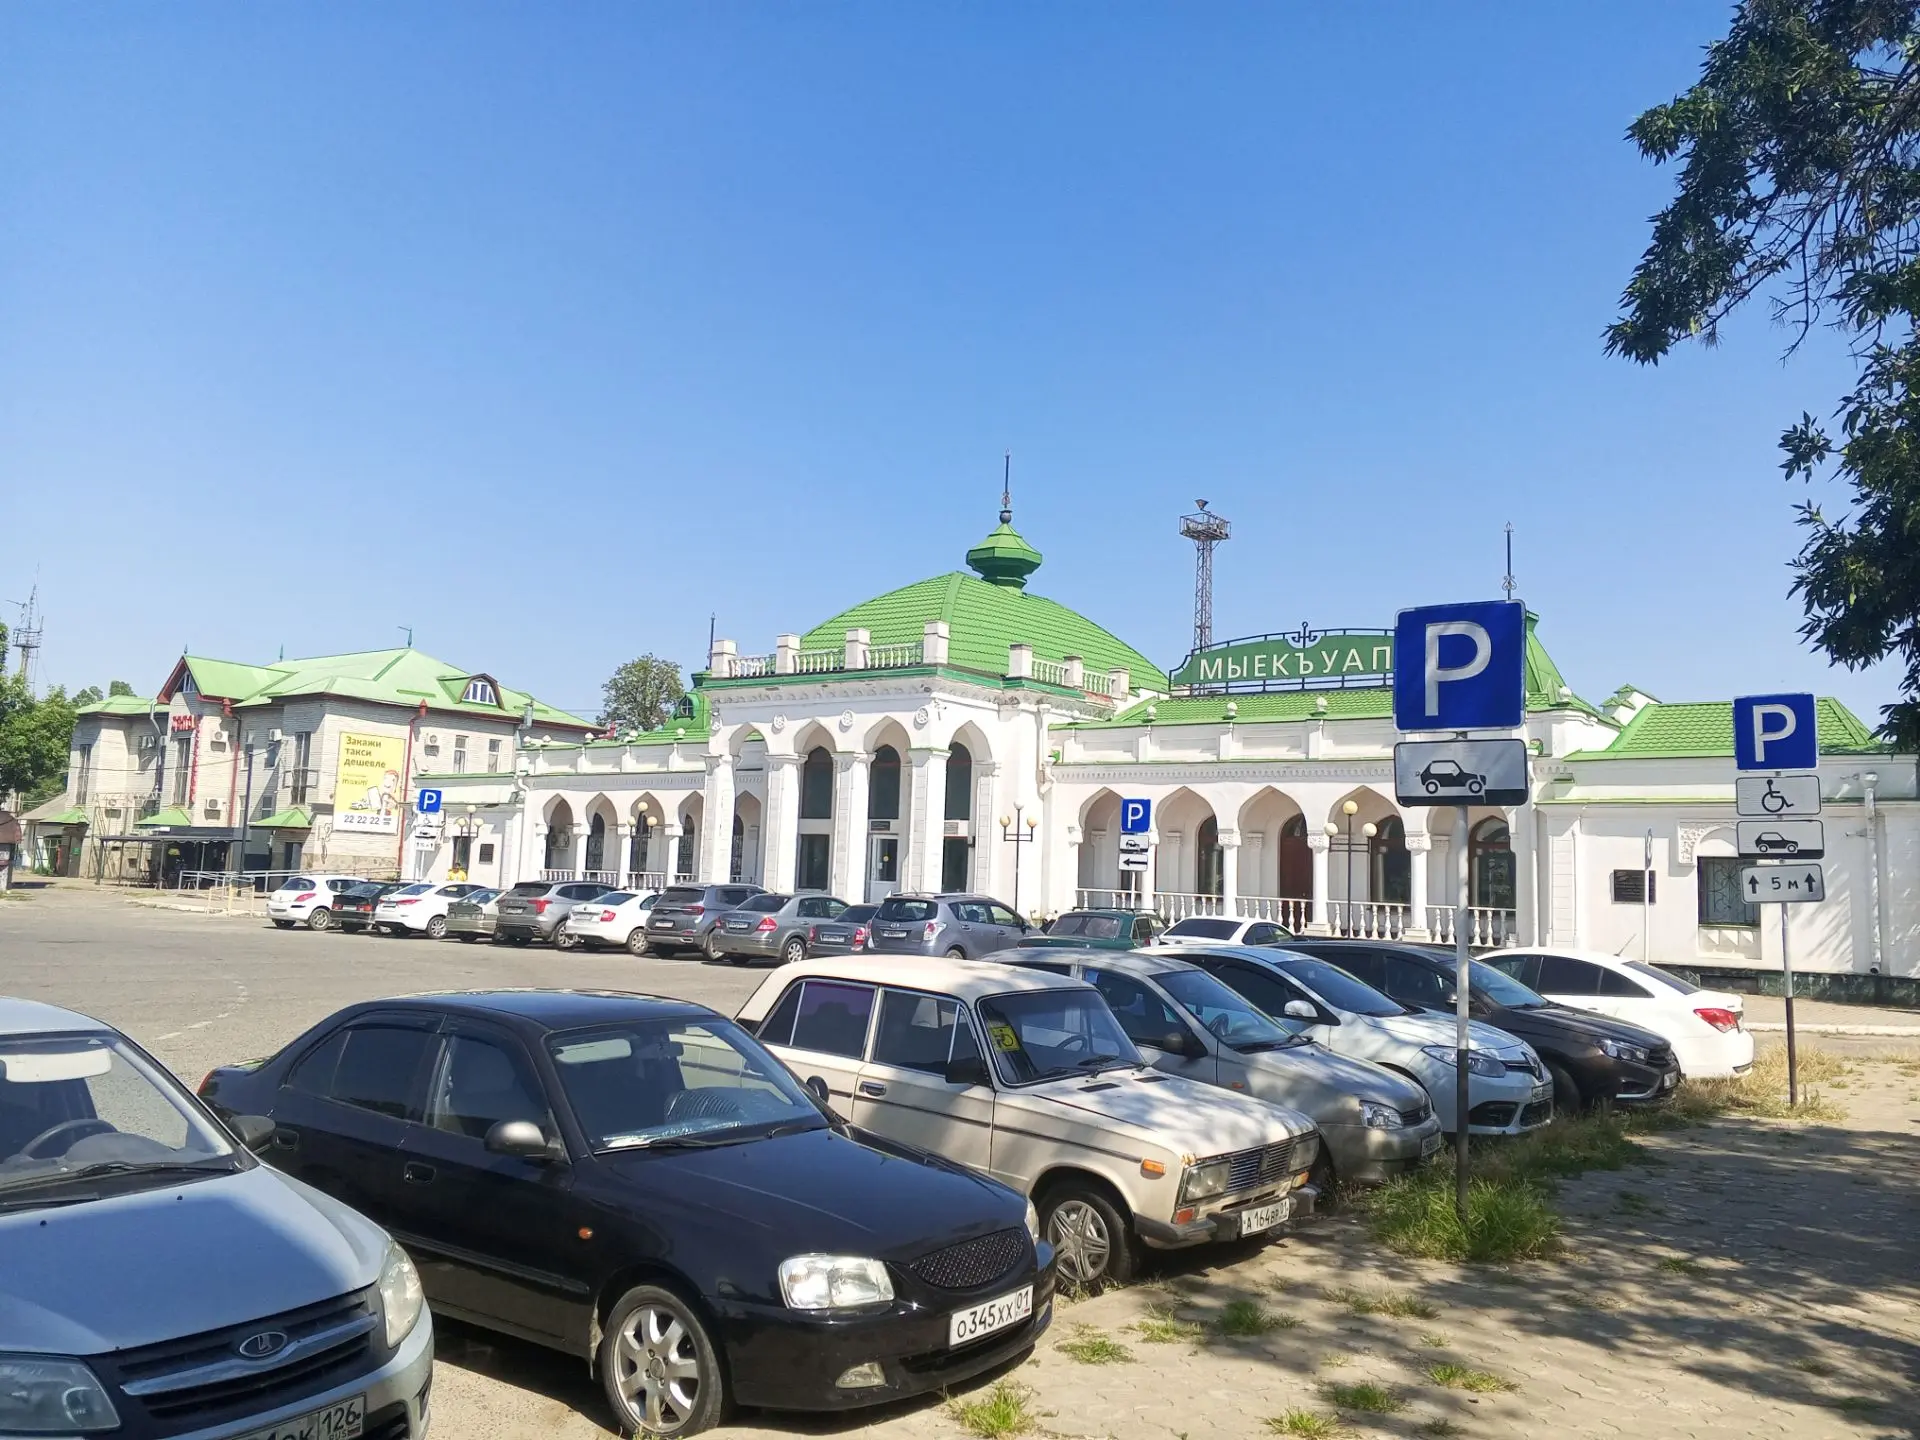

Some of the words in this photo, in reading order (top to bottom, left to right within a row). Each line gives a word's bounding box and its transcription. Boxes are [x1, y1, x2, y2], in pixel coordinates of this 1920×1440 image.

[1200, 646, 1391, 680] МЫЕКЪУАП
[1425, 621, 1491, 716] P
[346, 736, 381, 748] Закажи
[1753, 704, 1796, 762] P
[345, 748, 372, 757] такси
[343, 758, 386, 768] дешевле
[424, 792, 437, 810] P
[344, 815, 354, 823] 22
[357, 816, 367, 824] 22
[369, 817, 380, 825] 22
[1127, 803, 1144, 829] P
[1771, 877, 1781, 890] 5
[1016, 1289, 1029, 1309] 01
[322, 1402, 356, 1434] 126
